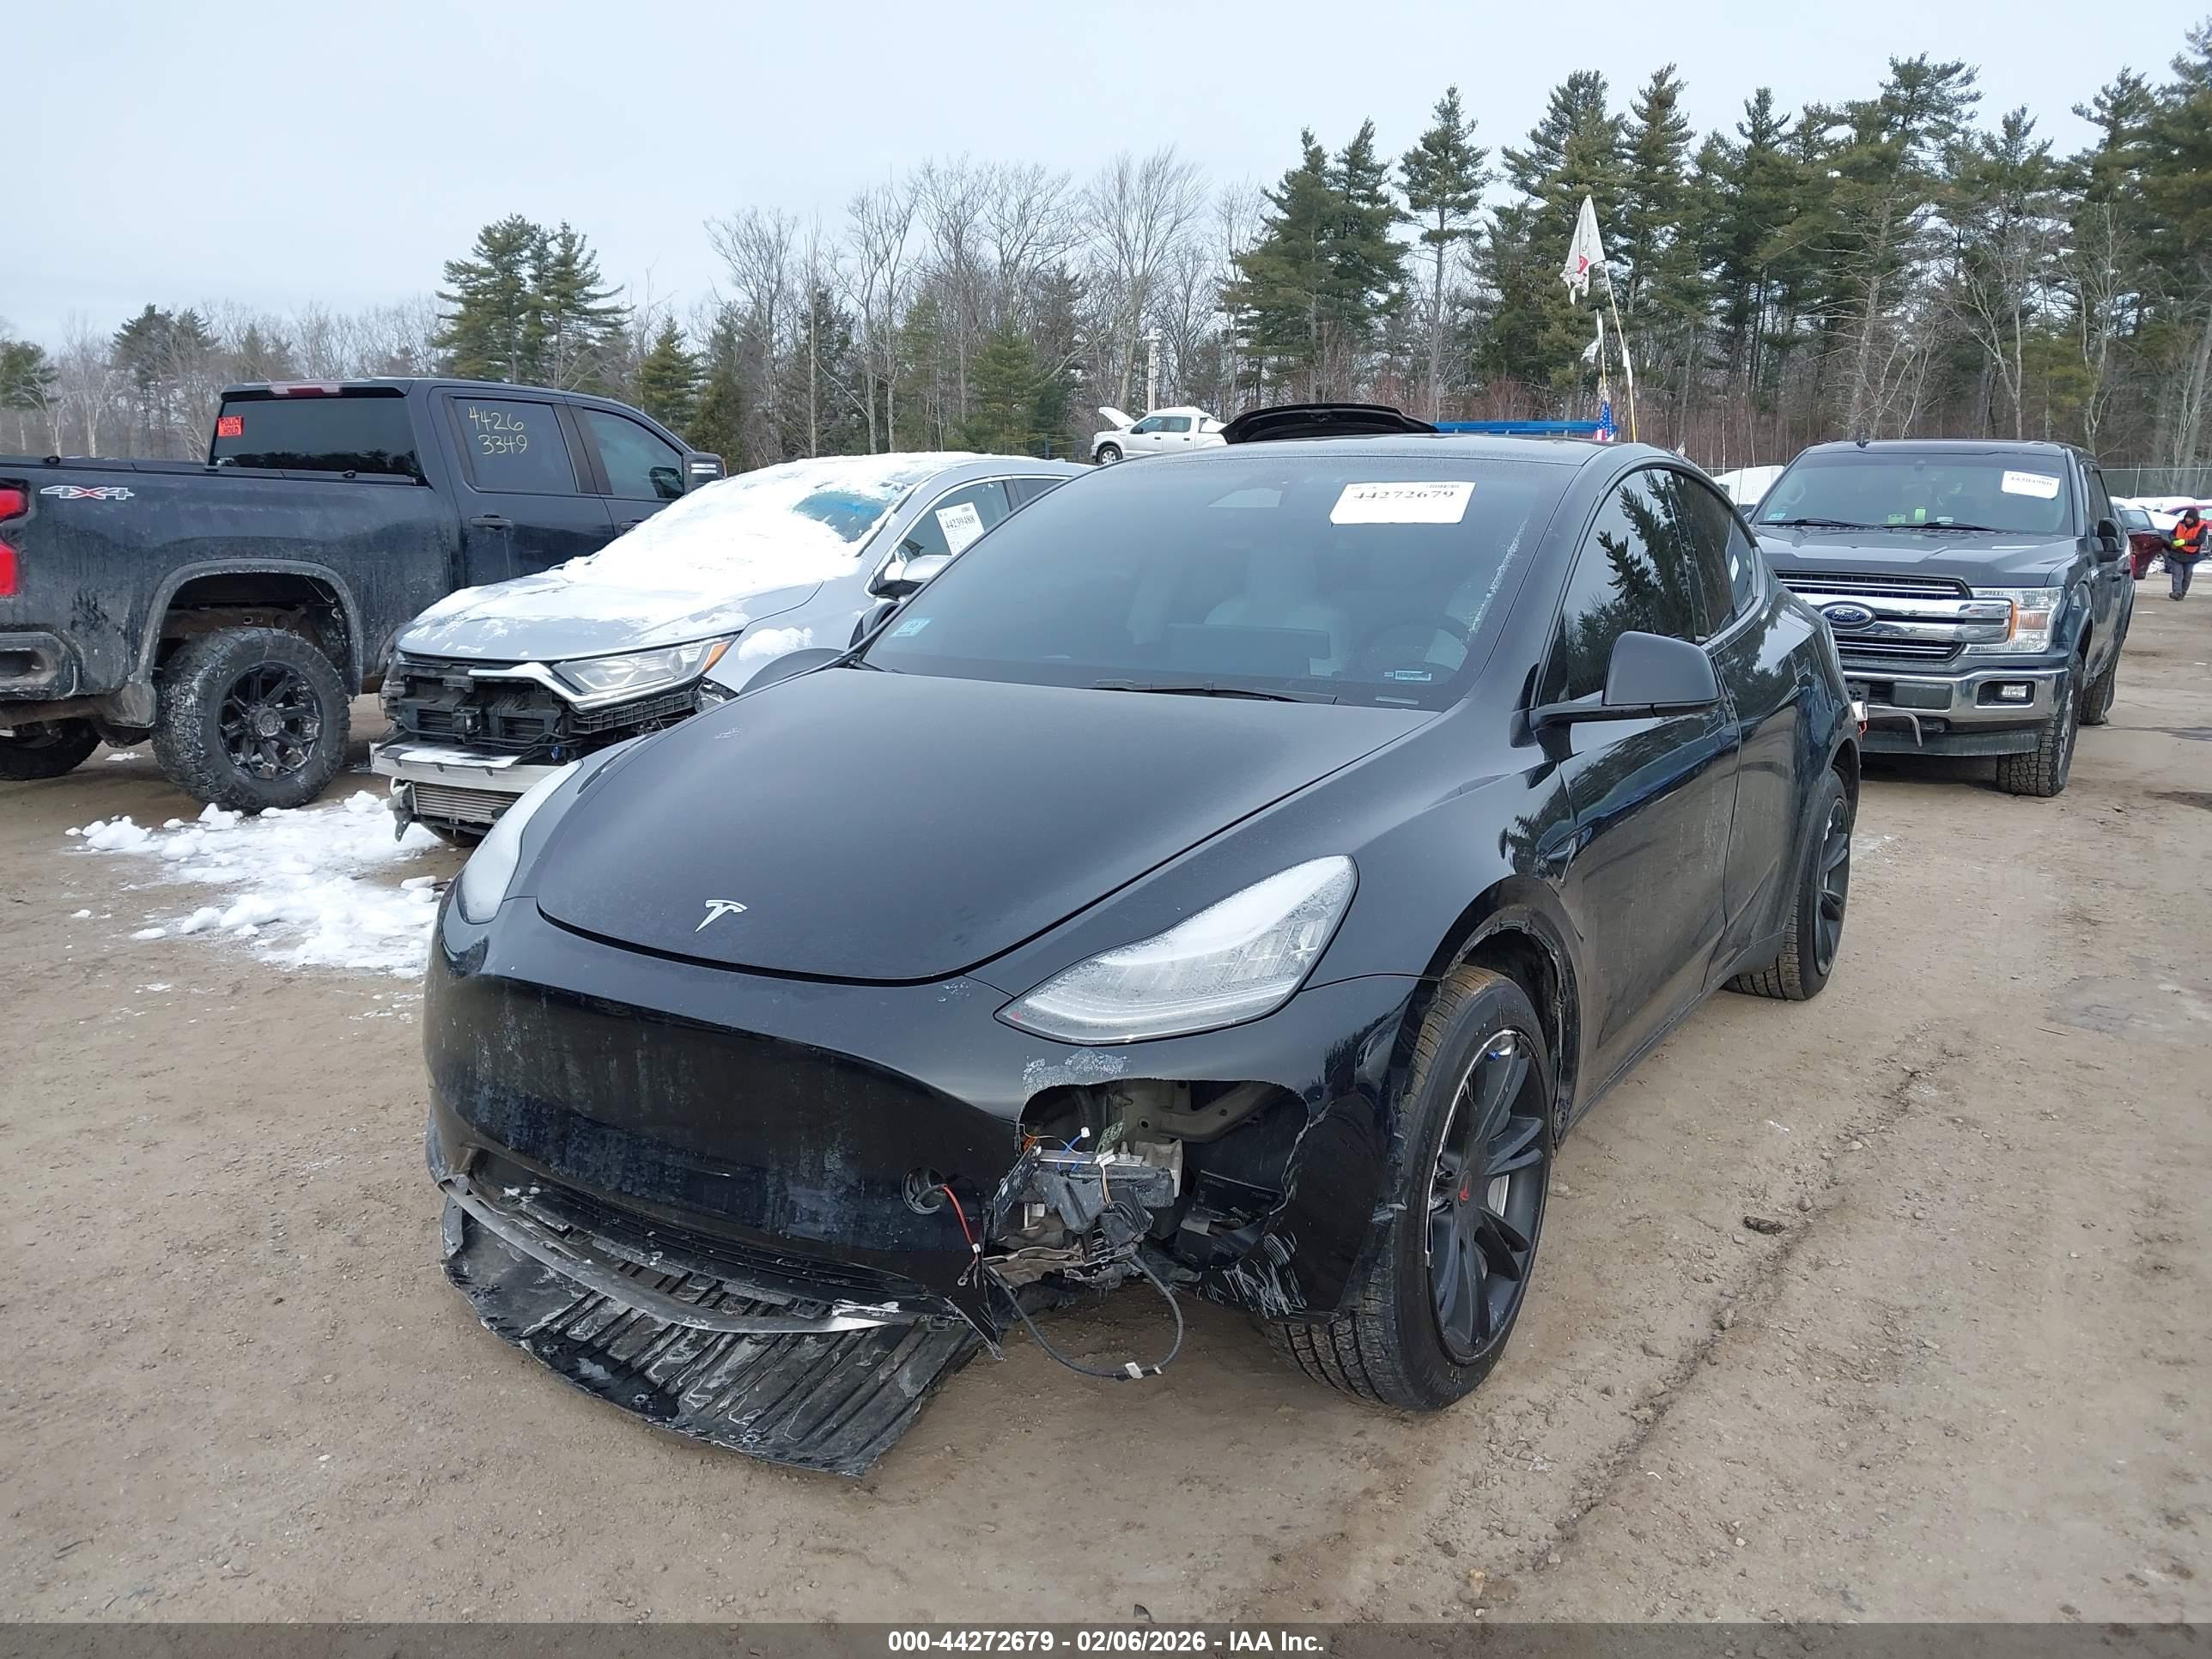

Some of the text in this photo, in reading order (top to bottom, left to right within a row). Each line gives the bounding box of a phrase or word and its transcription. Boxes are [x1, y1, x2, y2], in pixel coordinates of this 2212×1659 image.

[468, 406, 524, 432] 4426
[477, 434, 527, 455] 3349
[1352, 490, 1455, 500] 44272679
[1832, 609, 1860, 619] Ford
